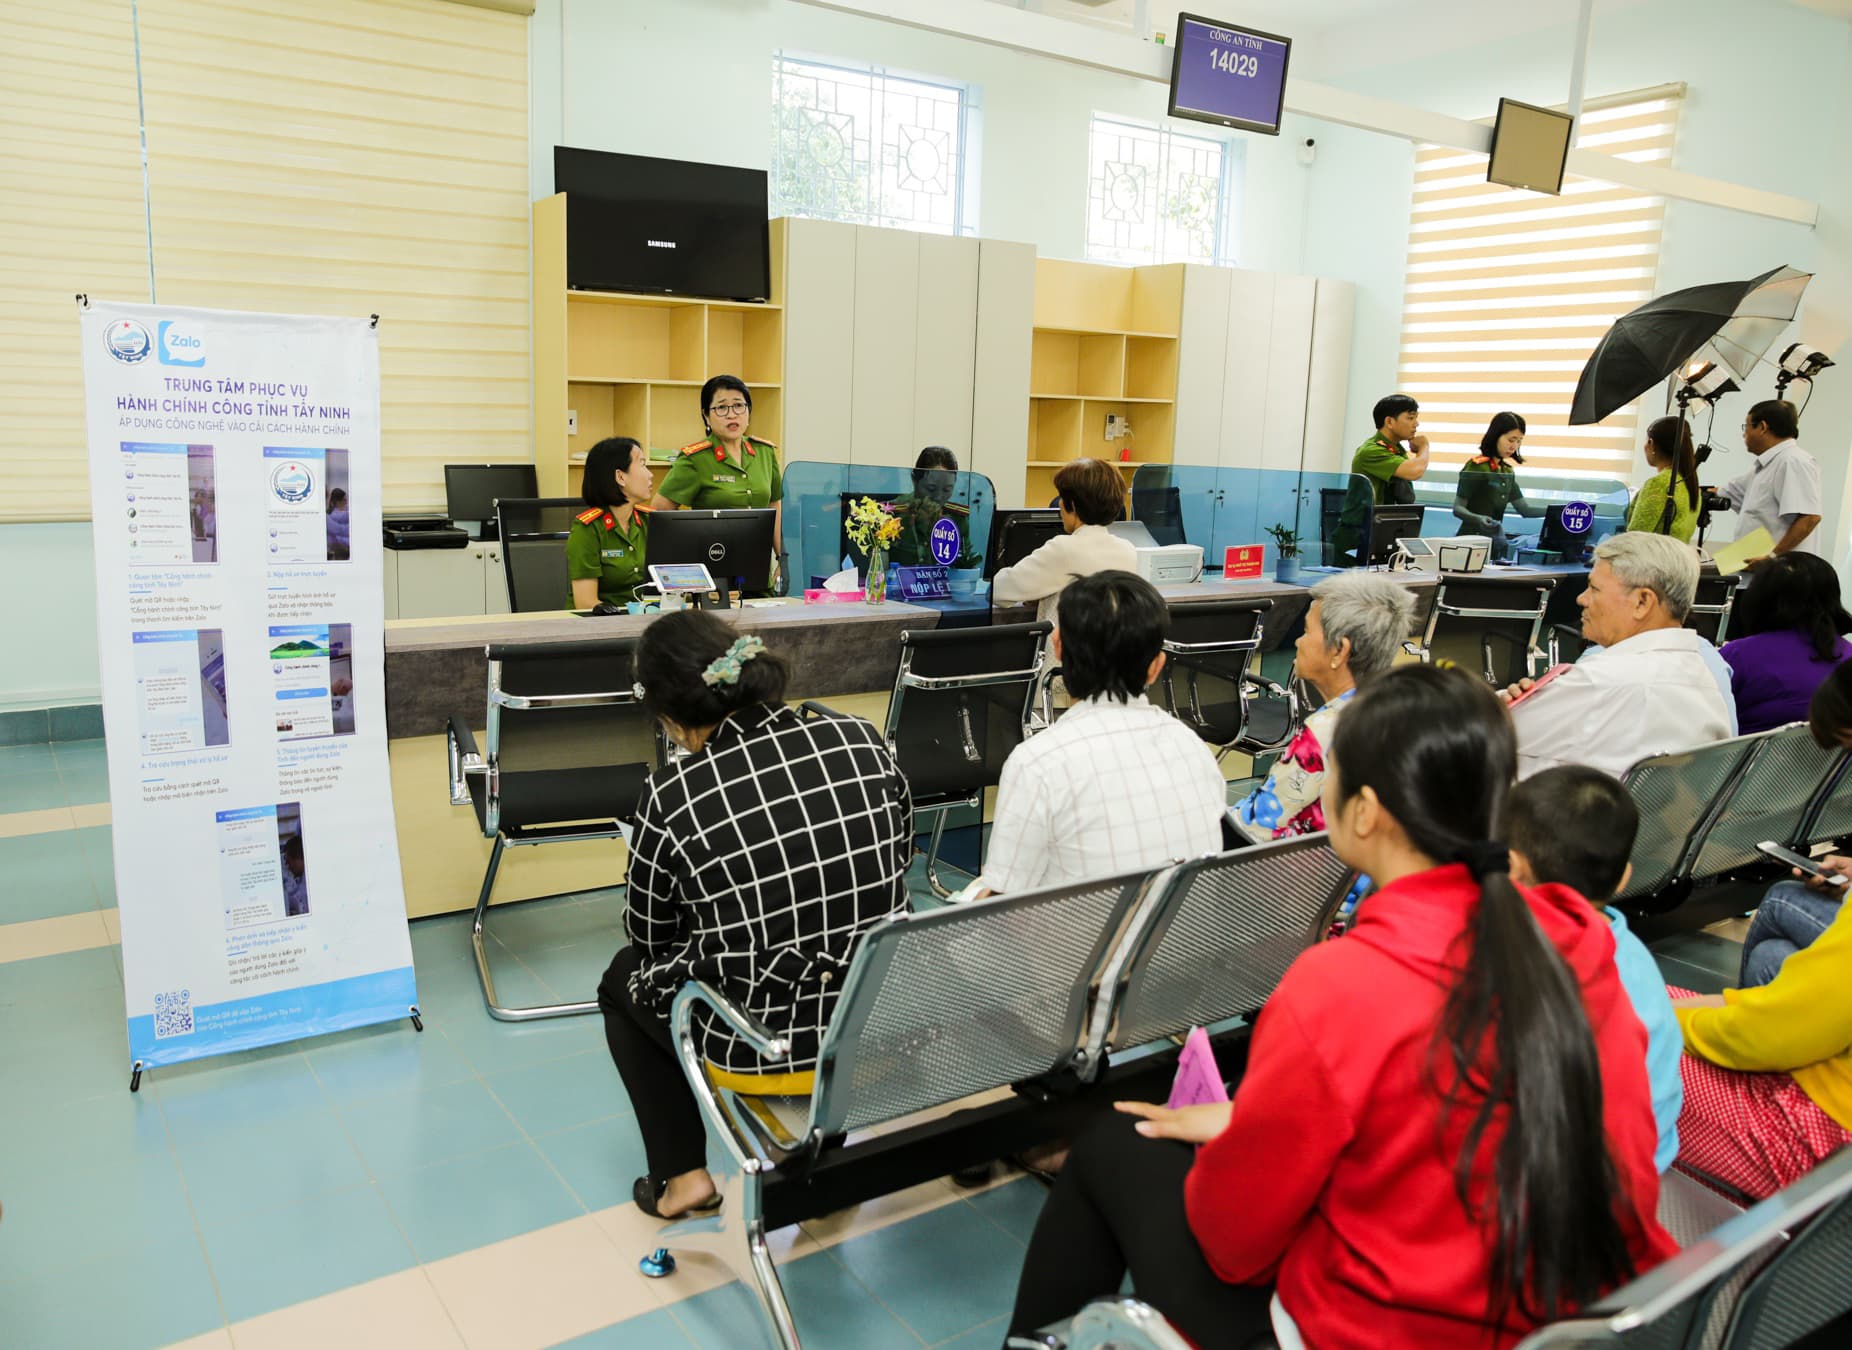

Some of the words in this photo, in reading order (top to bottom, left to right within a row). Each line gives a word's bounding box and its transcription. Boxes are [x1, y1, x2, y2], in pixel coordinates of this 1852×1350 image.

[1210, 30, 1231, 44] CÔNG
[1232, 36, 1243, 46] AN
[1244, 38, 1263, 51] TỈNH
[1210, 48, 1258, 78] 14029
[648, 240, 676, 248] SAMSUNG
[170, 334, 201, 349] Zalo
[164, 378, 212, 393] TRUNG
[217, 378, 245, 395] TÂM
[249, 382, 286, 400] PHỤC
[290, 384, 308, 401] VỤ
[117, 394, 157, 412] HÀNH
[162, 397, 207, 414] CHÍNH
[212, 398, 253, 416] CÔNG
[257, 400, 288, 418] TỈNH
[292, 402, 315, 418] TÂY
[319, 406, 351, 420] NINH
[166, 418, 195, 431] CÔNG
[1569, 518, 1584, 529] 15
[938, 542, 950, 559] 14
[910, 581, 930, 596] NỘP
[932, 582, 945, 596] LỆ
